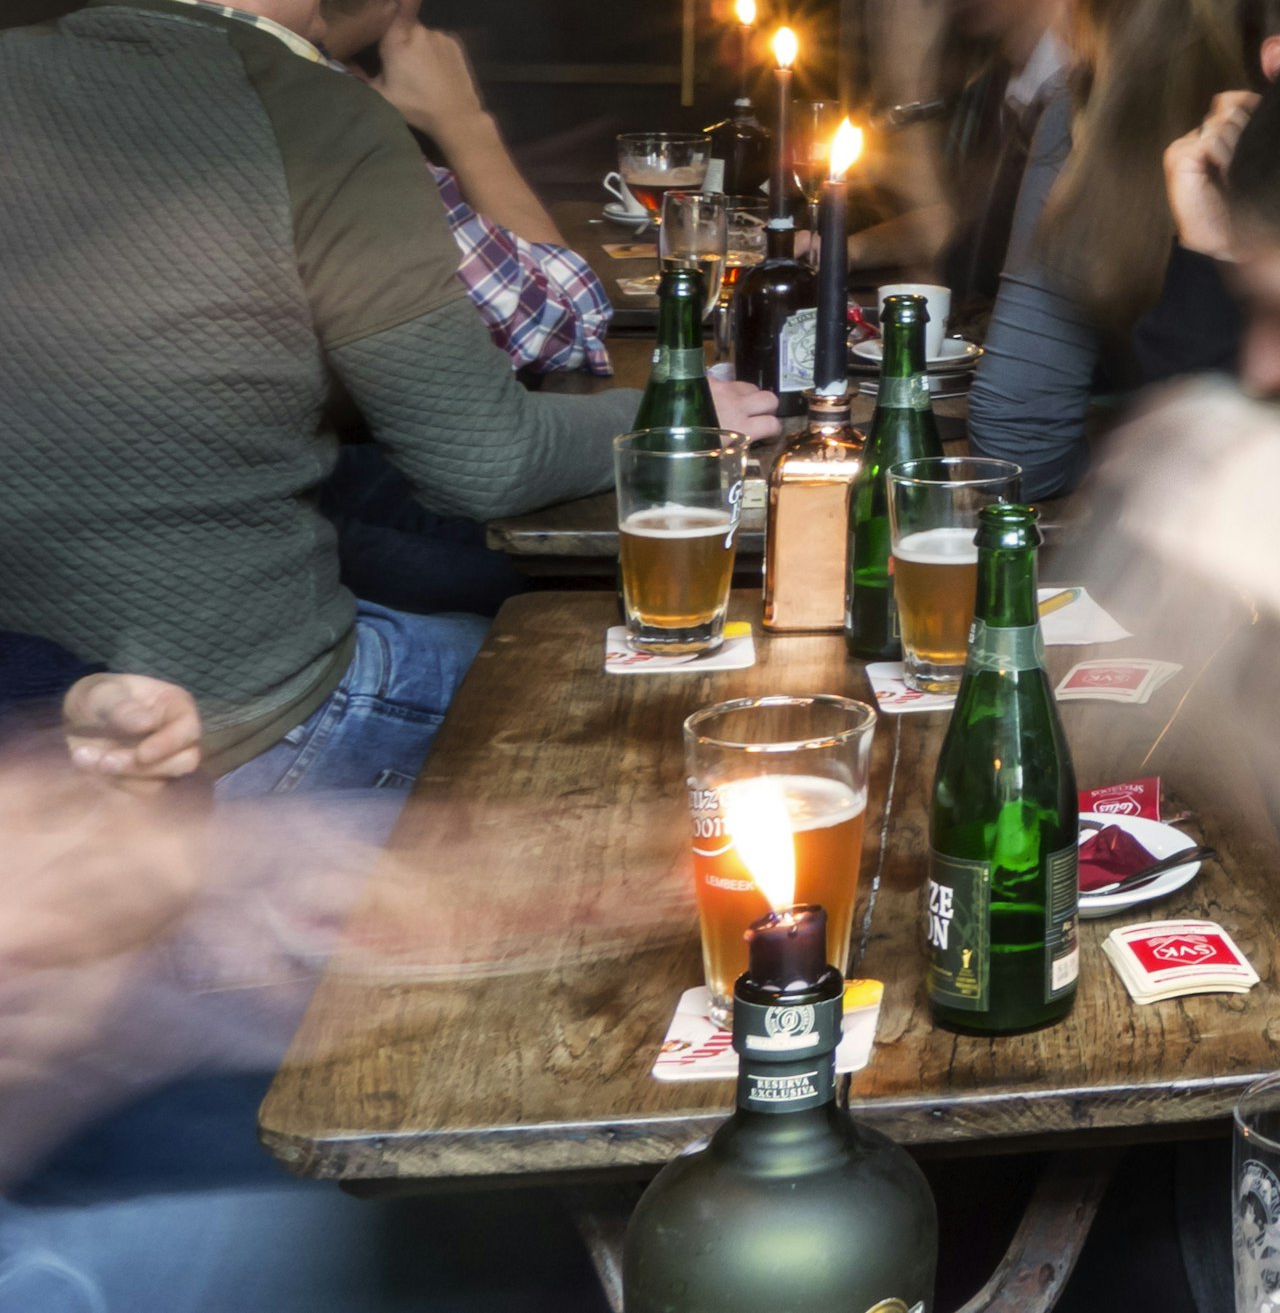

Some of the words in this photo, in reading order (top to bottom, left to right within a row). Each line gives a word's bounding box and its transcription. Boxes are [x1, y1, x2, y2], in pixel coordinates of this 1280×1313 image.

[1098, 799, 1134, 816] Lotus
[1159, 942, 1211, 958] SVK
[756, 1077, 810, 1089] RESERVA
[751, 1086, 816, 1099] EXCLUSIVA
